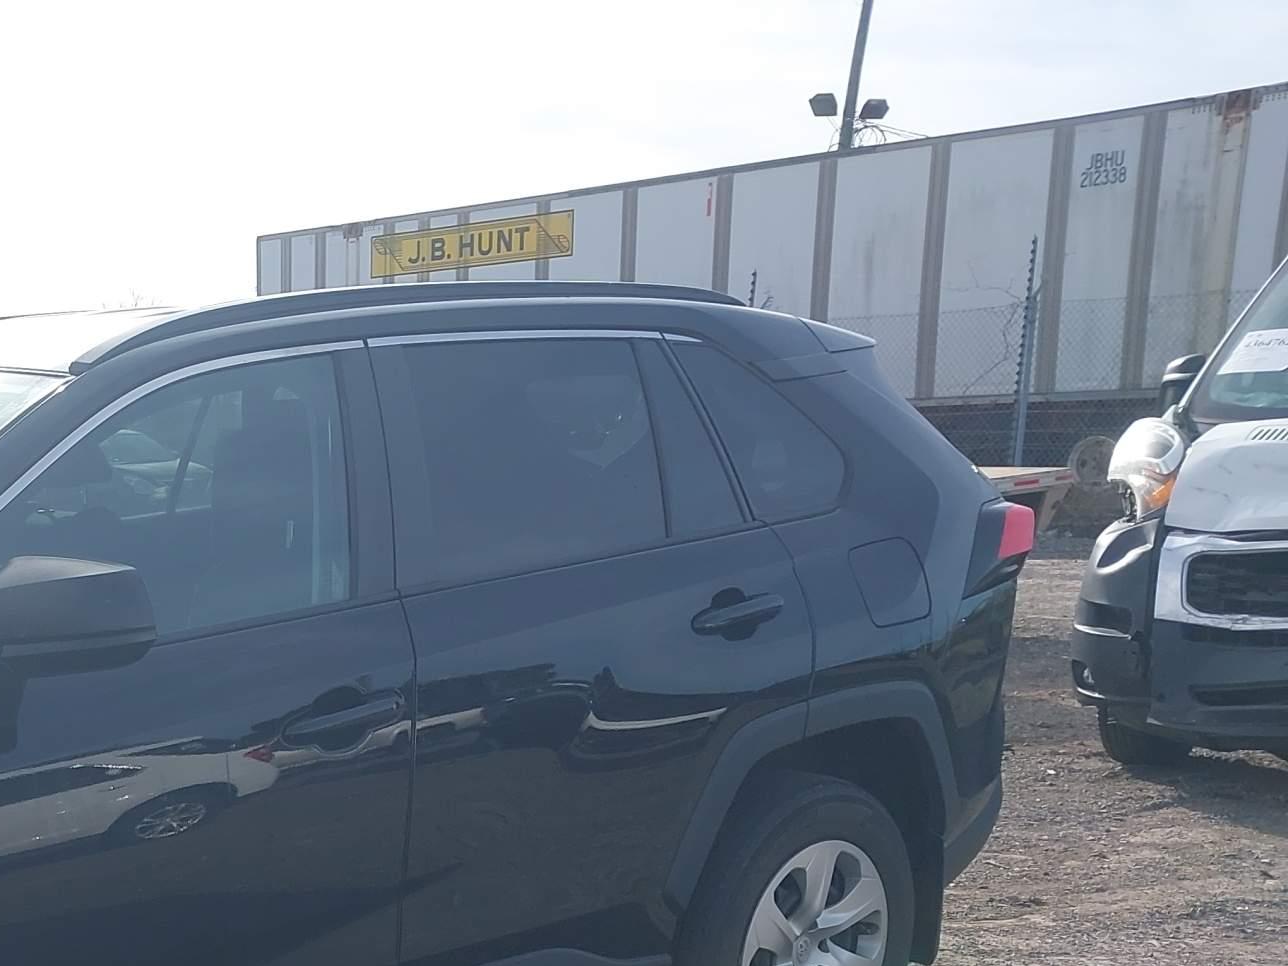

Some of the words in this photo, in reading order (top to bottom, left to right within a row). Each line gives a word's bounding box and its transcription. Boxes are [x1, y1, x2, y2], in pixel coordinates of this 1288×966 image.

[1085, 150, 1125, 170] JBHU
[1080, 166, 1127, 188] 212338
[407, 240, 426, 264] J.
[431, 237, 451, 261] B.
[459, 226, 530, 257] HUNT
